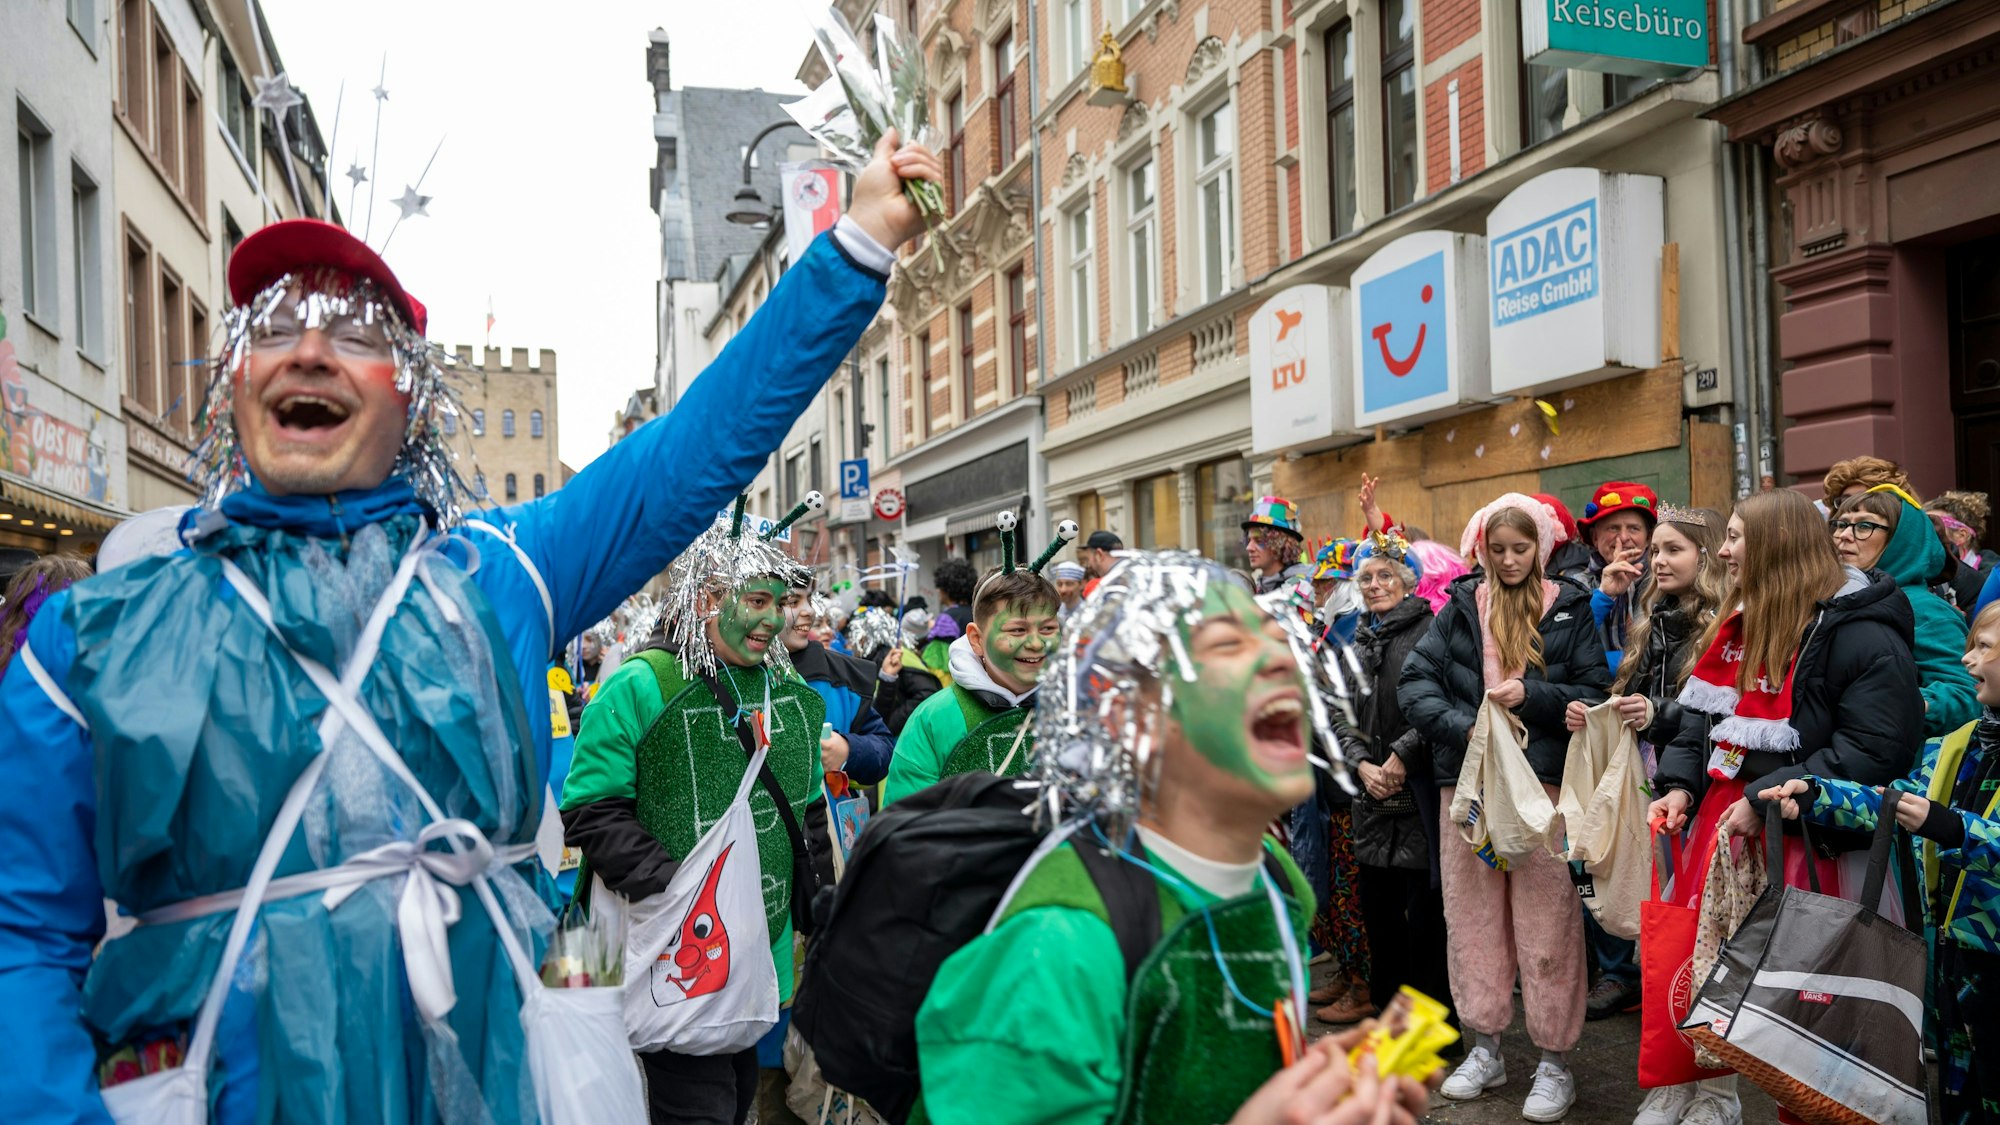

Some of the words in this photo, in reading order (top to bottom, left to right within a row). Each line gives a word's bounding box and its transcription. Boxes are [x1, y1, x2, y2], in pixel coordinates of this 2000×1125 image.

[1553, 0, 1702, 39] Reisebüro
[1499, 217, 1587, 289] ADAC
[1498, 292, 1539, 320] Reise
[1541, 267, 1592, 306] GmbH
[1272, 358, 1306, 391] LTU
[1698, 370, 1716, 389] 29
[32, 416, 65, 457] OBS
[843, 464, 861, 495] P
